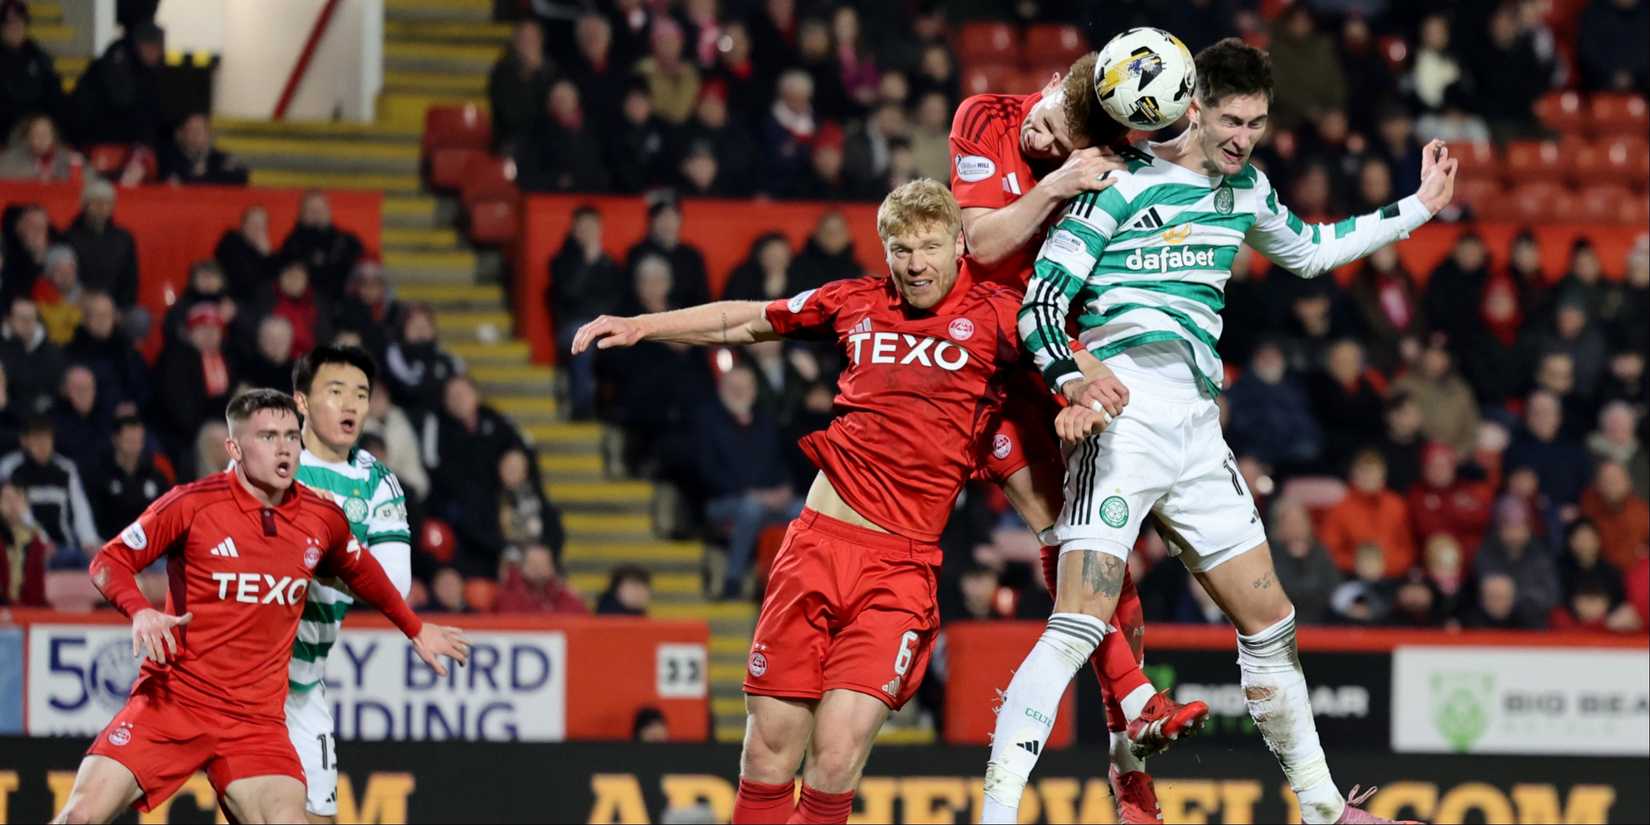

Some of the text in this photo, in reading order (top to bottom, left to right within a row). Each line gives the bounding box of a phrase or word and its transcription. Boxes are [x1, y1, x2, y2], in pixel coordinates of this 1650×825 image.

[1125, 246, 1215, 273] dafabet
[848, 332, 969, 371] TEXO
[212, 572, 308, 606] TEXO
[405, 643, 552, 692] BIRD
[894, 630, 918, 676] 6
